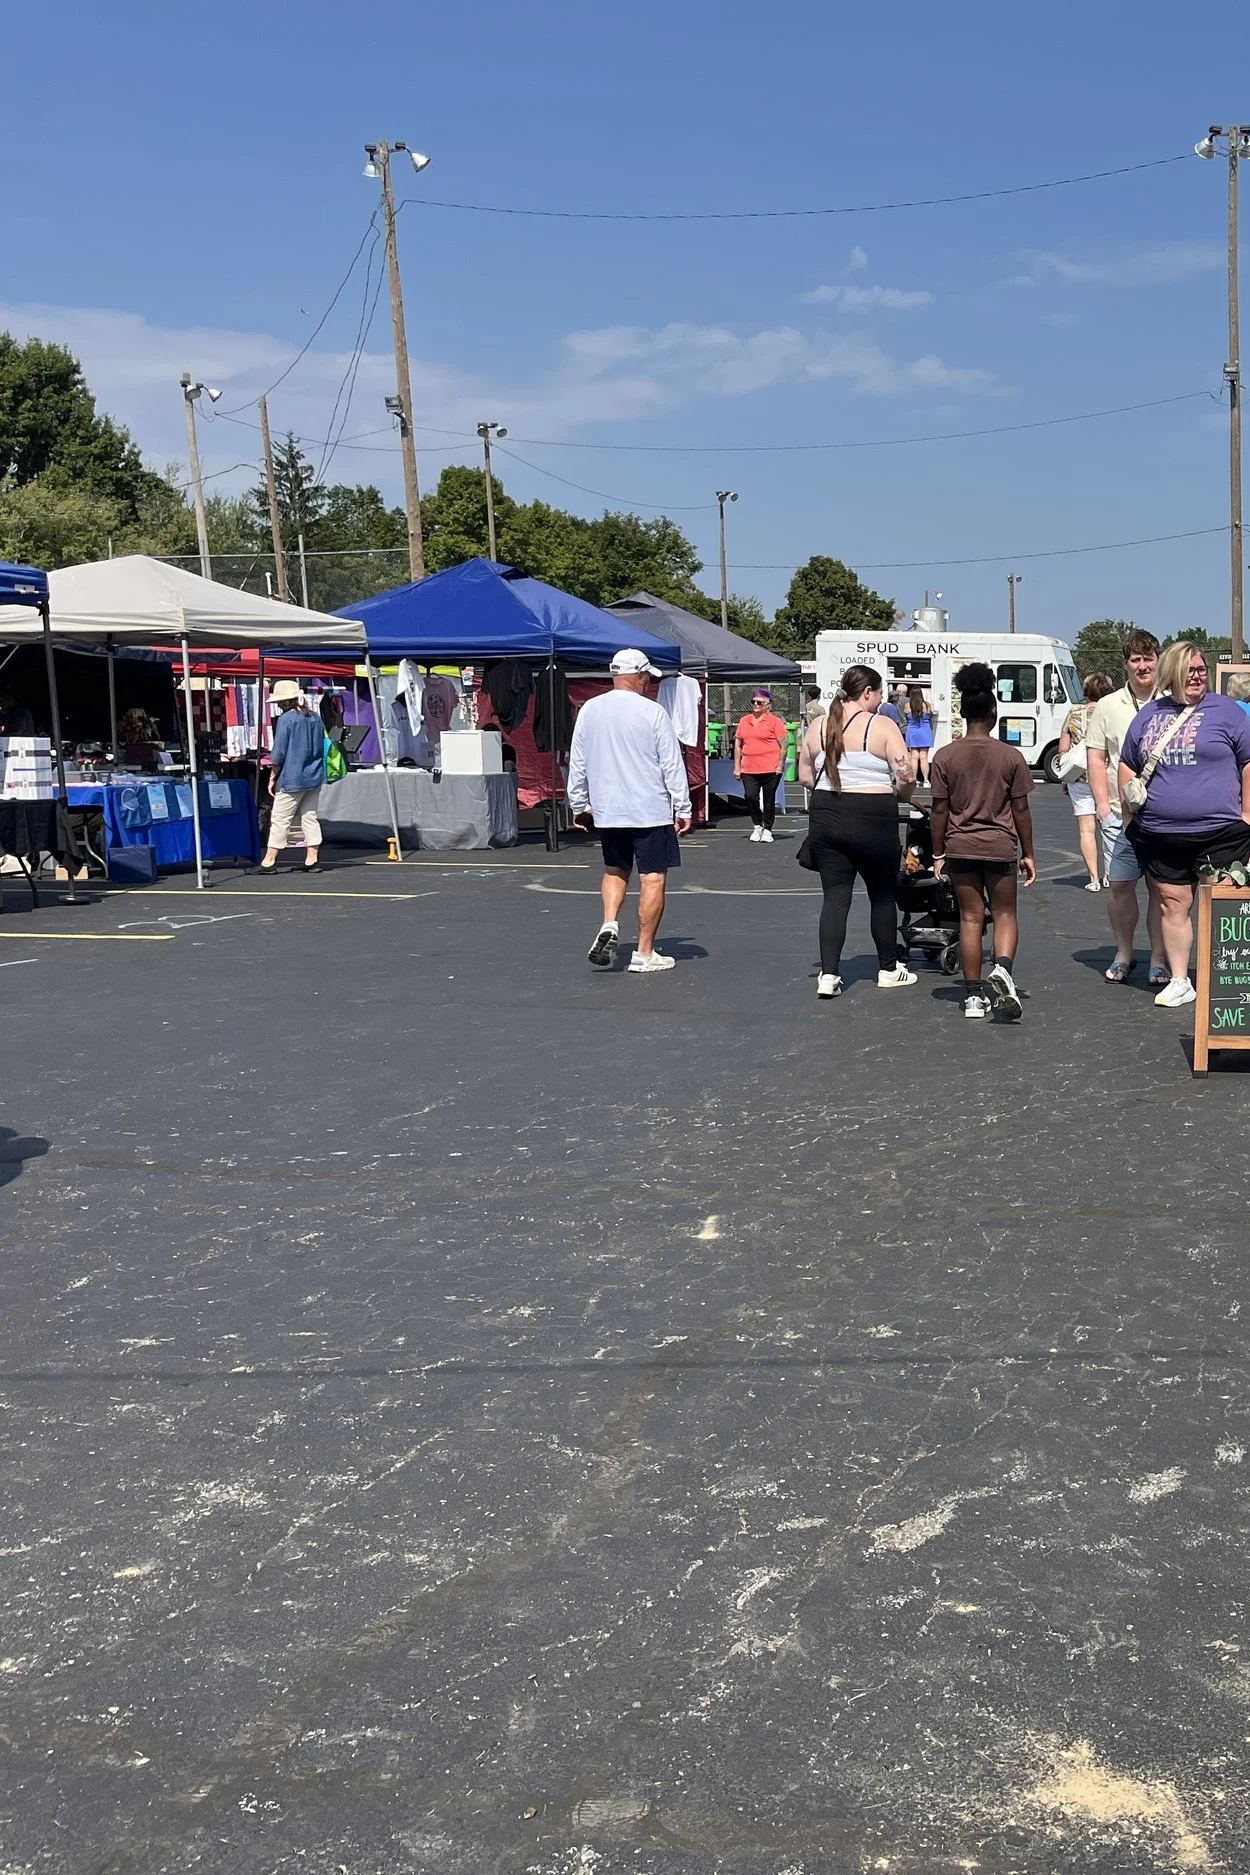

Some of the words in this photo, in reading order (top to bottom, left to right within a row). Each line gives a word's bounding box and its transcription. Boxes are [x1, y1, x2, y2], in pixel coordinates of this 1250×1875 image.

[856, 642, 899, 653] SPUD
[916, 643, 960, 654] BANK
[840, 656, 876, 665] LOADED
[1221, 946, 1239, 961] try
[1230, 961, 1245, 970] ITCH
[1219, 976, 1233, 985] BYE
[1211, 1007, 1246, 1029] SAVE
